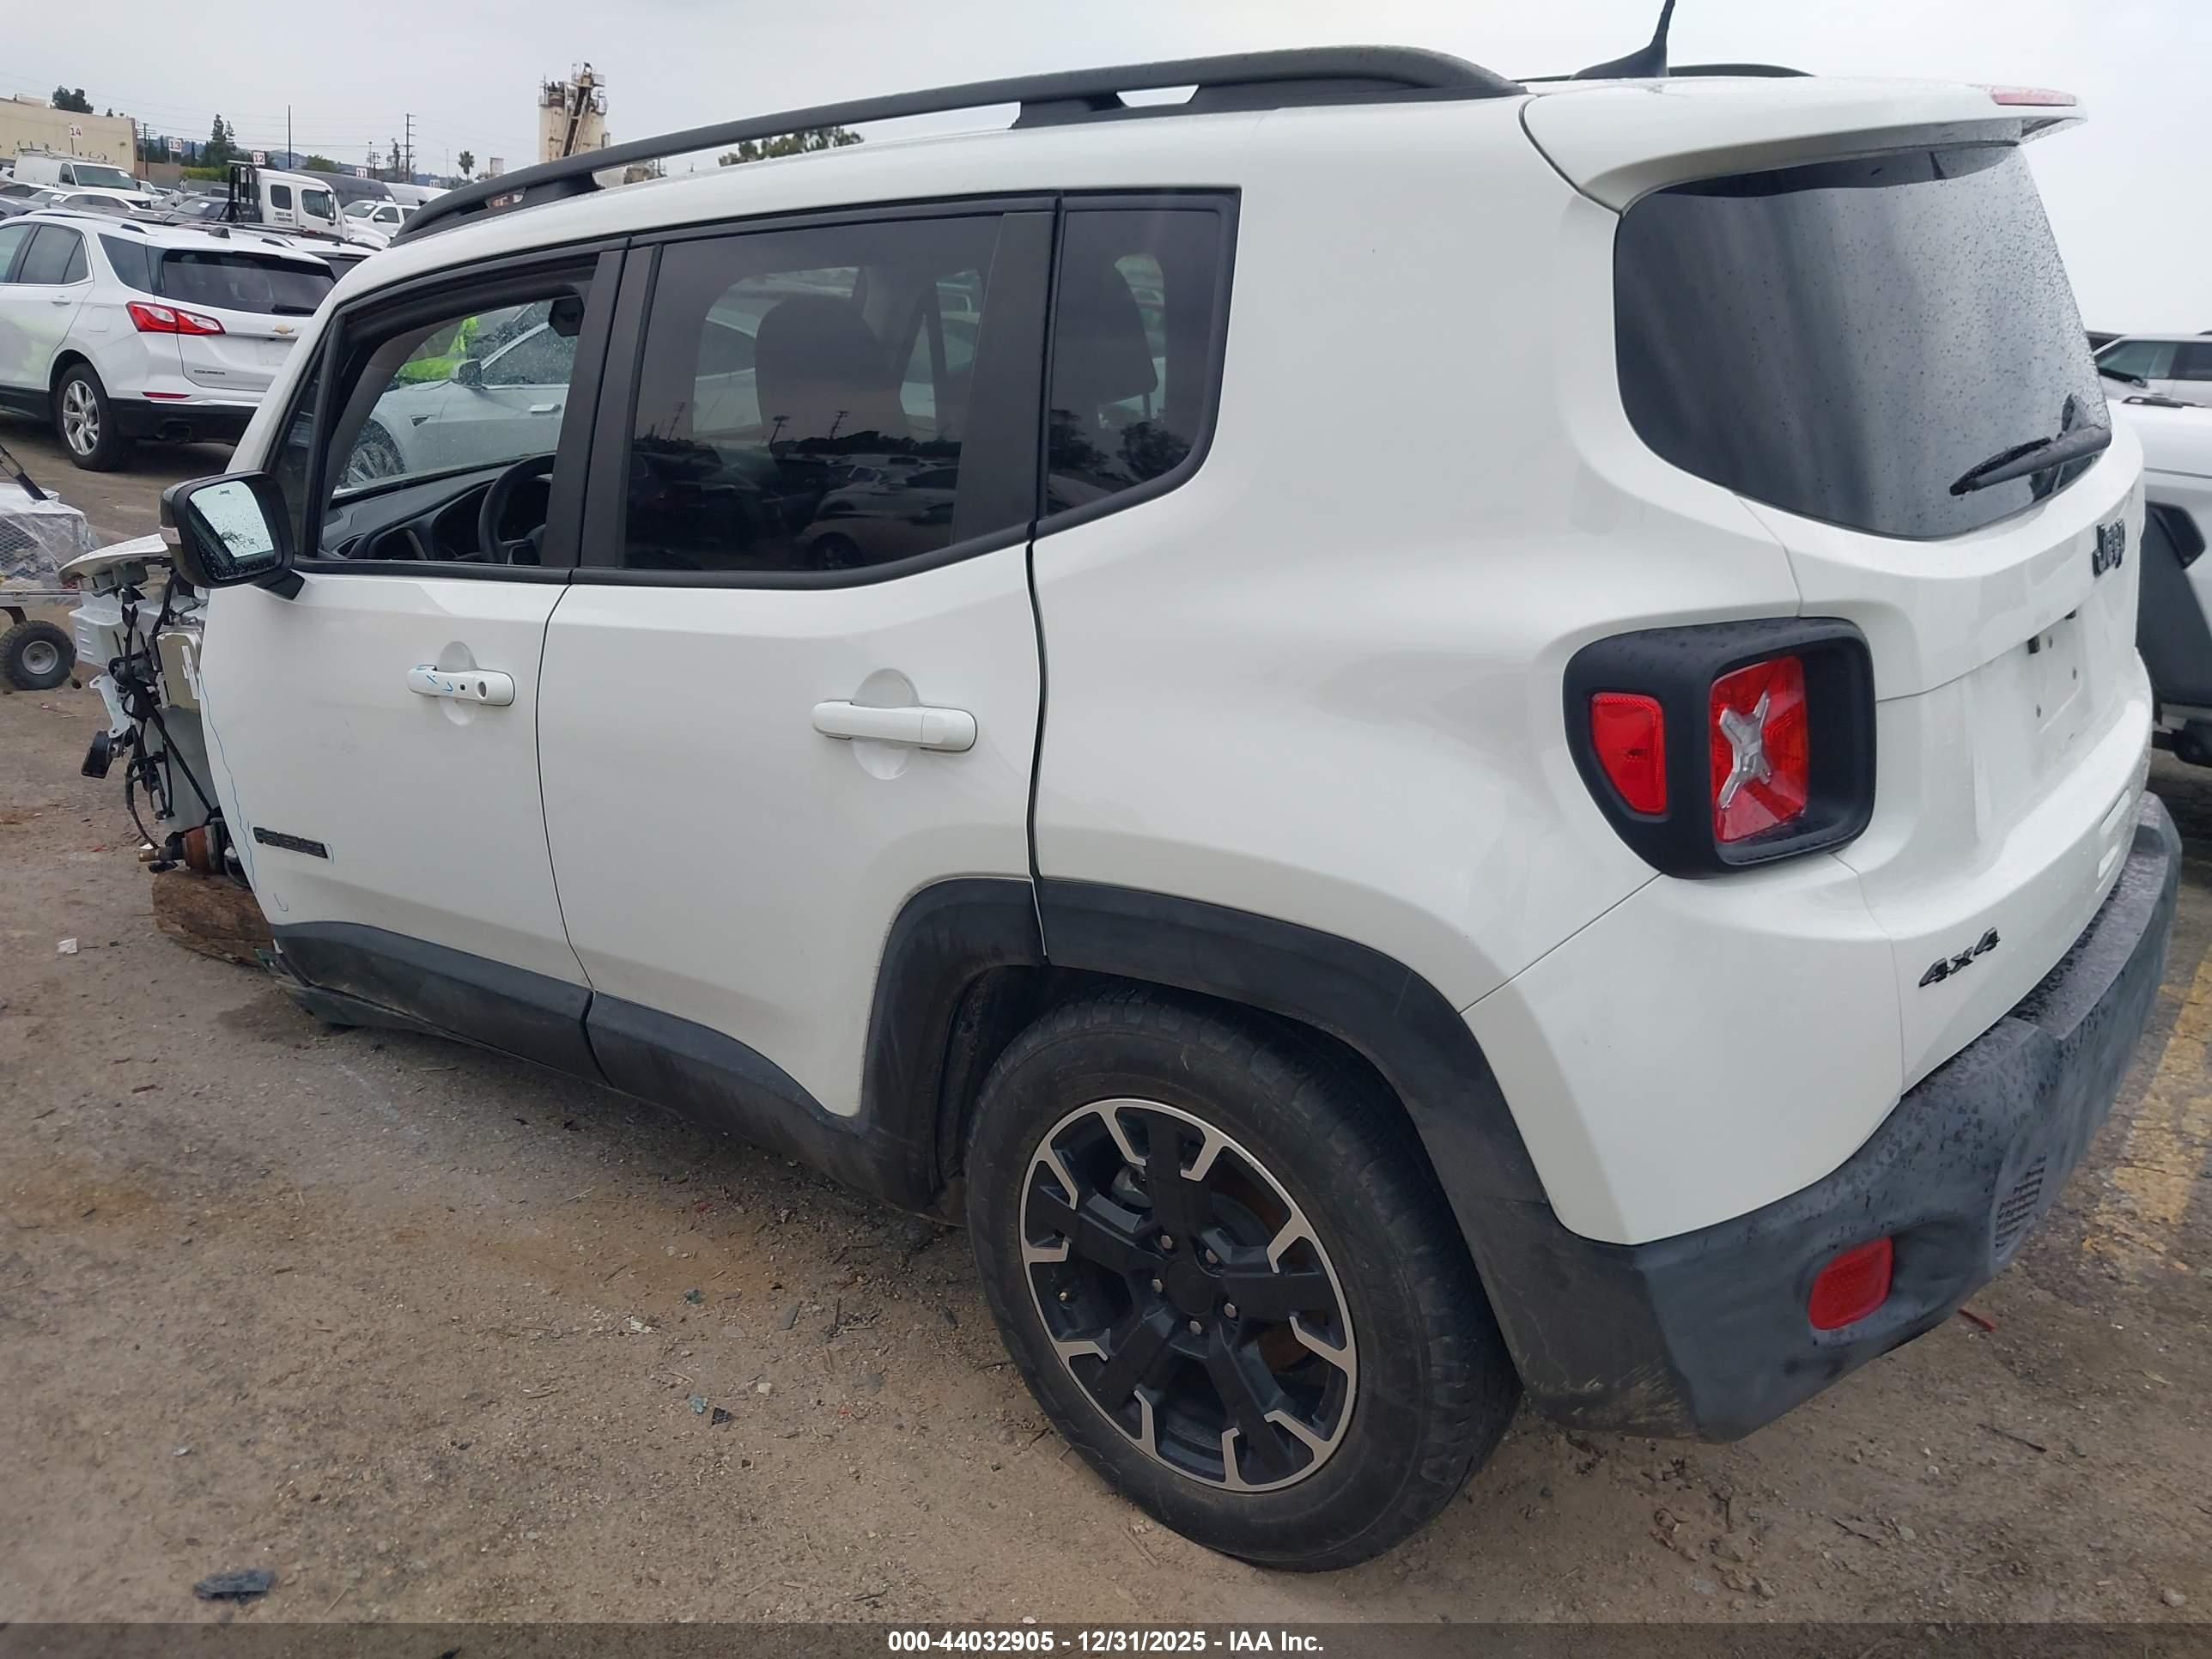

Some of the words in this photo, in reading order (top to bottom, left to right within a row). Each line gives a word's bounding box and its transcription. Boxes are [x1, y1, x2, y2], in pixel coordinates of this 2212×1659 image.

[70, 127, 82, 137] 14
[170, 141, 180, 150] 13
[254, 154, 264, 163] 12
[356, 168, 367, 178] 11
